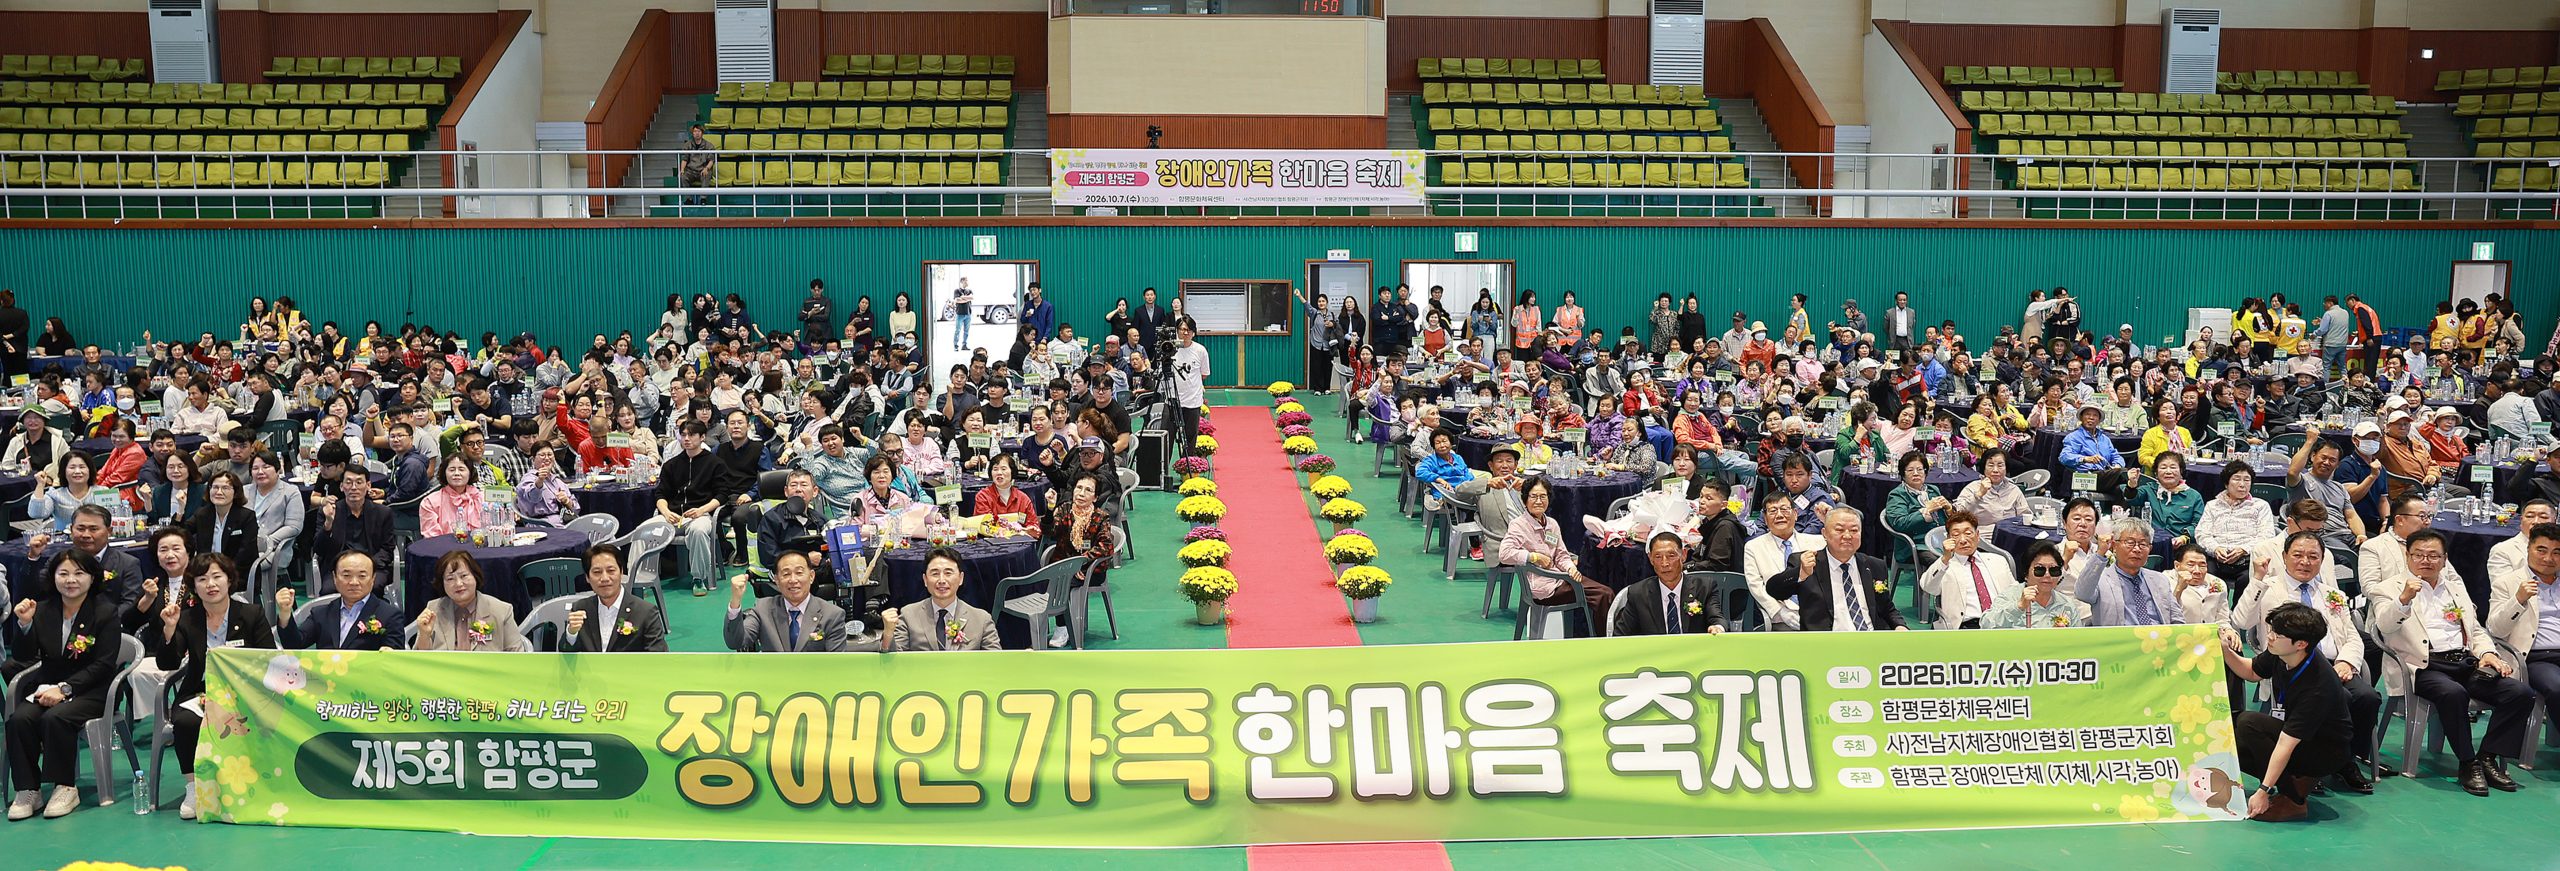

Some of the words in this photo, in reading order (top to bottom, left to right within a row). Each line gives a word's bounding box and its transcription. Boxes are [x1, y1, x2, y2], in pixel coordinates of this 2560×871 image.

[1079, 173, 1105, 185] 제5회
[1107, 173, 1135, 185] 함평군
[1156, 159, 1273, 188] 장애인가족
[1279, 158, 1349, 188] 한마음
[1356, 158, 1402, 188] 축제
[1085, 195, 1140, 203] 2026.10.7.(수)
[1838, 671, 1860, 683] 일시
[1881, 662, 2032, 686] 2026.10.7.(수)
[2038, 661, 2096, 683] 10:30
[316, 700, 380, 721] 함께하는
[383, 698, 417, 722] 일상,
[421, 698, 462, 721] 행복한
[466, 698, 501, 722] 함평,
[506, 699, 547, 720] 하나
[552, 699, 587, 722] 되는
[591, 700, 628, 722] 우리
[1840, 705, 1863, 718] 장소
[1882, 698, 2030, 721] 함평문화체육센터
[657, 690, 1214, 809] 장애인가족
[1232, 680, 1568, 802] 한마음
[1599, 668, 1817, 794] 축제
[1843, 739, 1866, 752] 주최
[1886, 729, 2074, 755] 사)전남지체장애인협회
[2079, 725, 2173, 749] 함평군지회
[351, 738, 467, 790] 제5회
[477, 738, 599, 790] 함평군
[1850, 771, 1872, 784] 주관
[1890, 766, 1948, 787] 함평군
[1951, 764, 2044, 786] 장애인단체
[2048, 759, 2179, 785] (지체,시각,농아)
